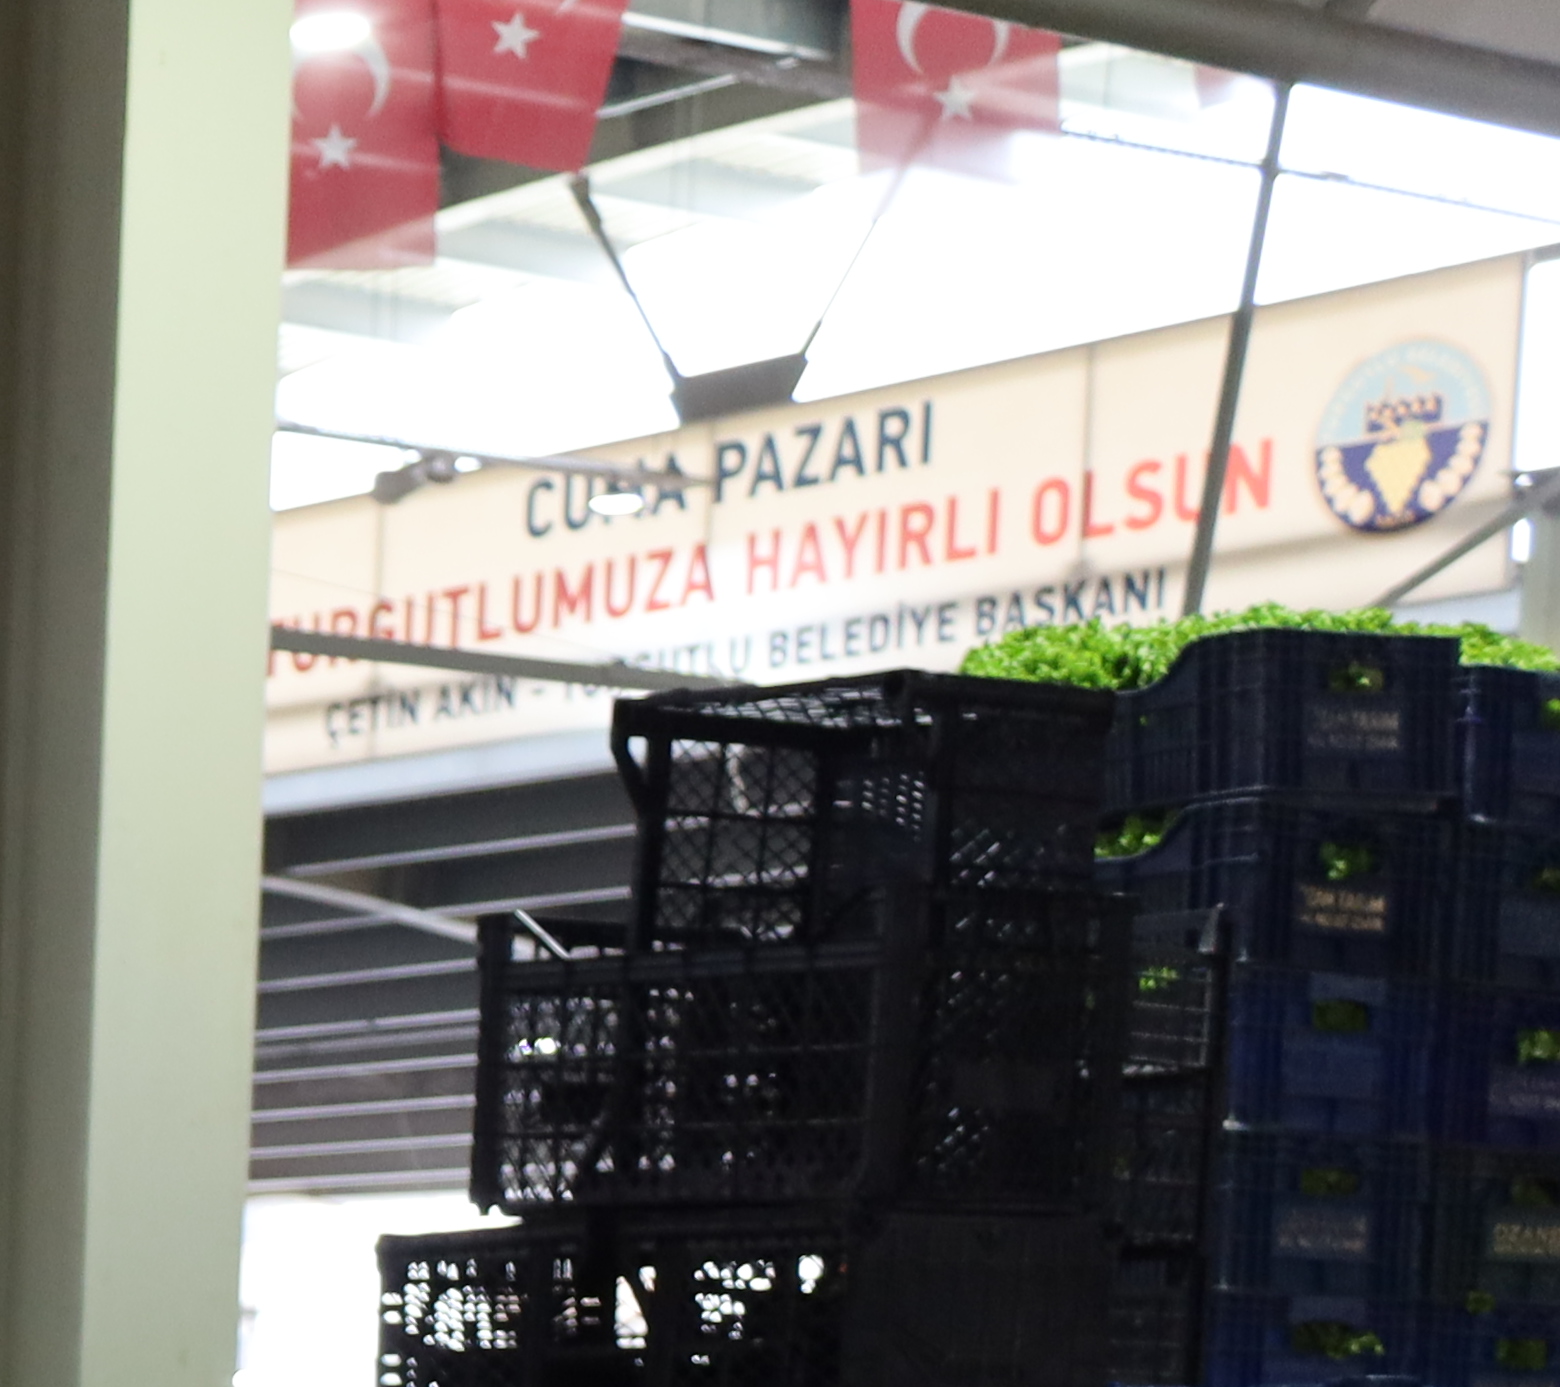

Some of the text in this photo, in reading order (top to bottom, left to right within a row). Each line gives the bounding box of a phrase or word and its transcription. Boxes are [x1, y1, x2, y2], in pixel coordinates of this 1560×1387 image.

[526, 400, 933, 538] CUMA PAZARI
[746, 487, 1000, 595] HAYIRLI
[1032, 437, 1274, 547] OLSUN
[768, 602, 960, 669] BELEDİYE
